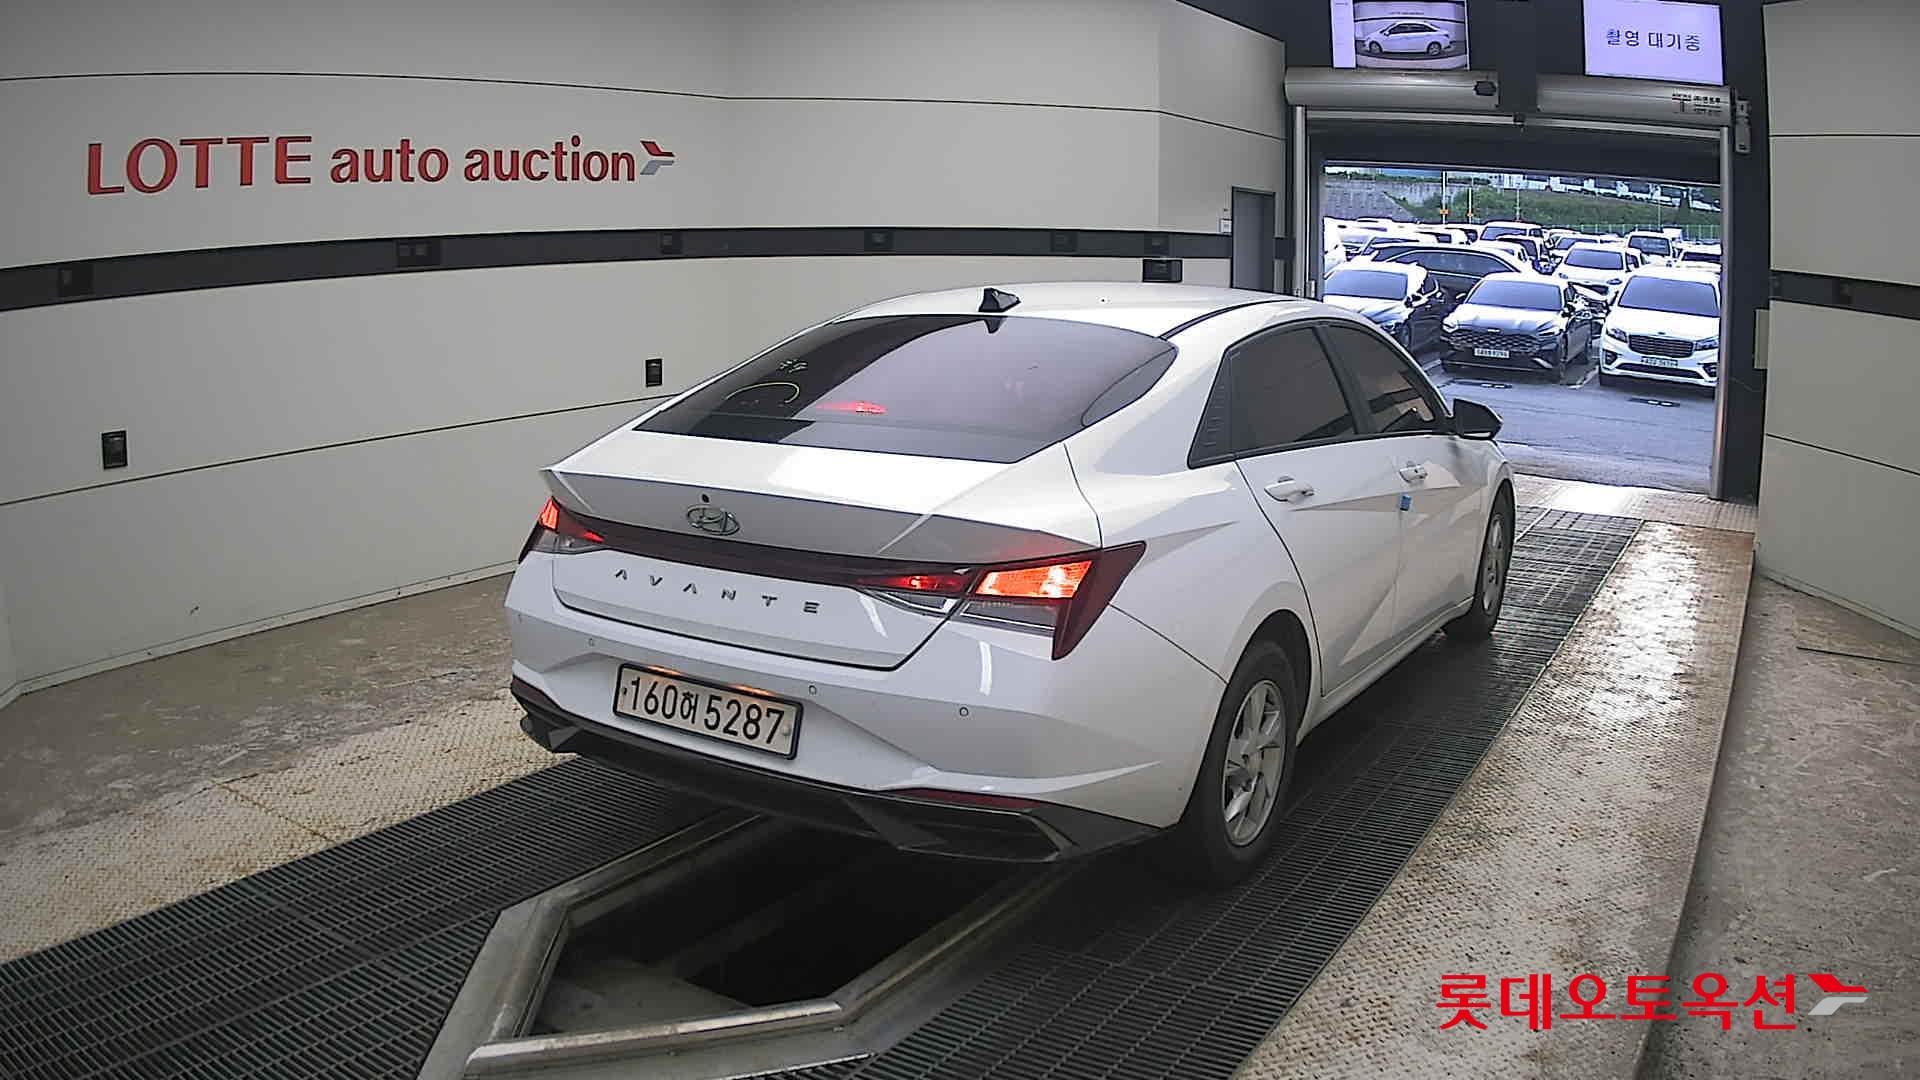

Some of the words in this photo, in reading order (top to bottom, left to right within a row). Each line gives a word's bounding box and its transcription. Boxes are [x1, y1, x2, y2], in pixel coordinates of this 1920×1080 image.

[1606, 28, 1640, 48] 촬영
[87, 136, 312, 195] LOTTE
[330, 139, 449, 184] auto
[463, 135, 636, 184] auction
[615, 569, 820, 614] AVANTE
